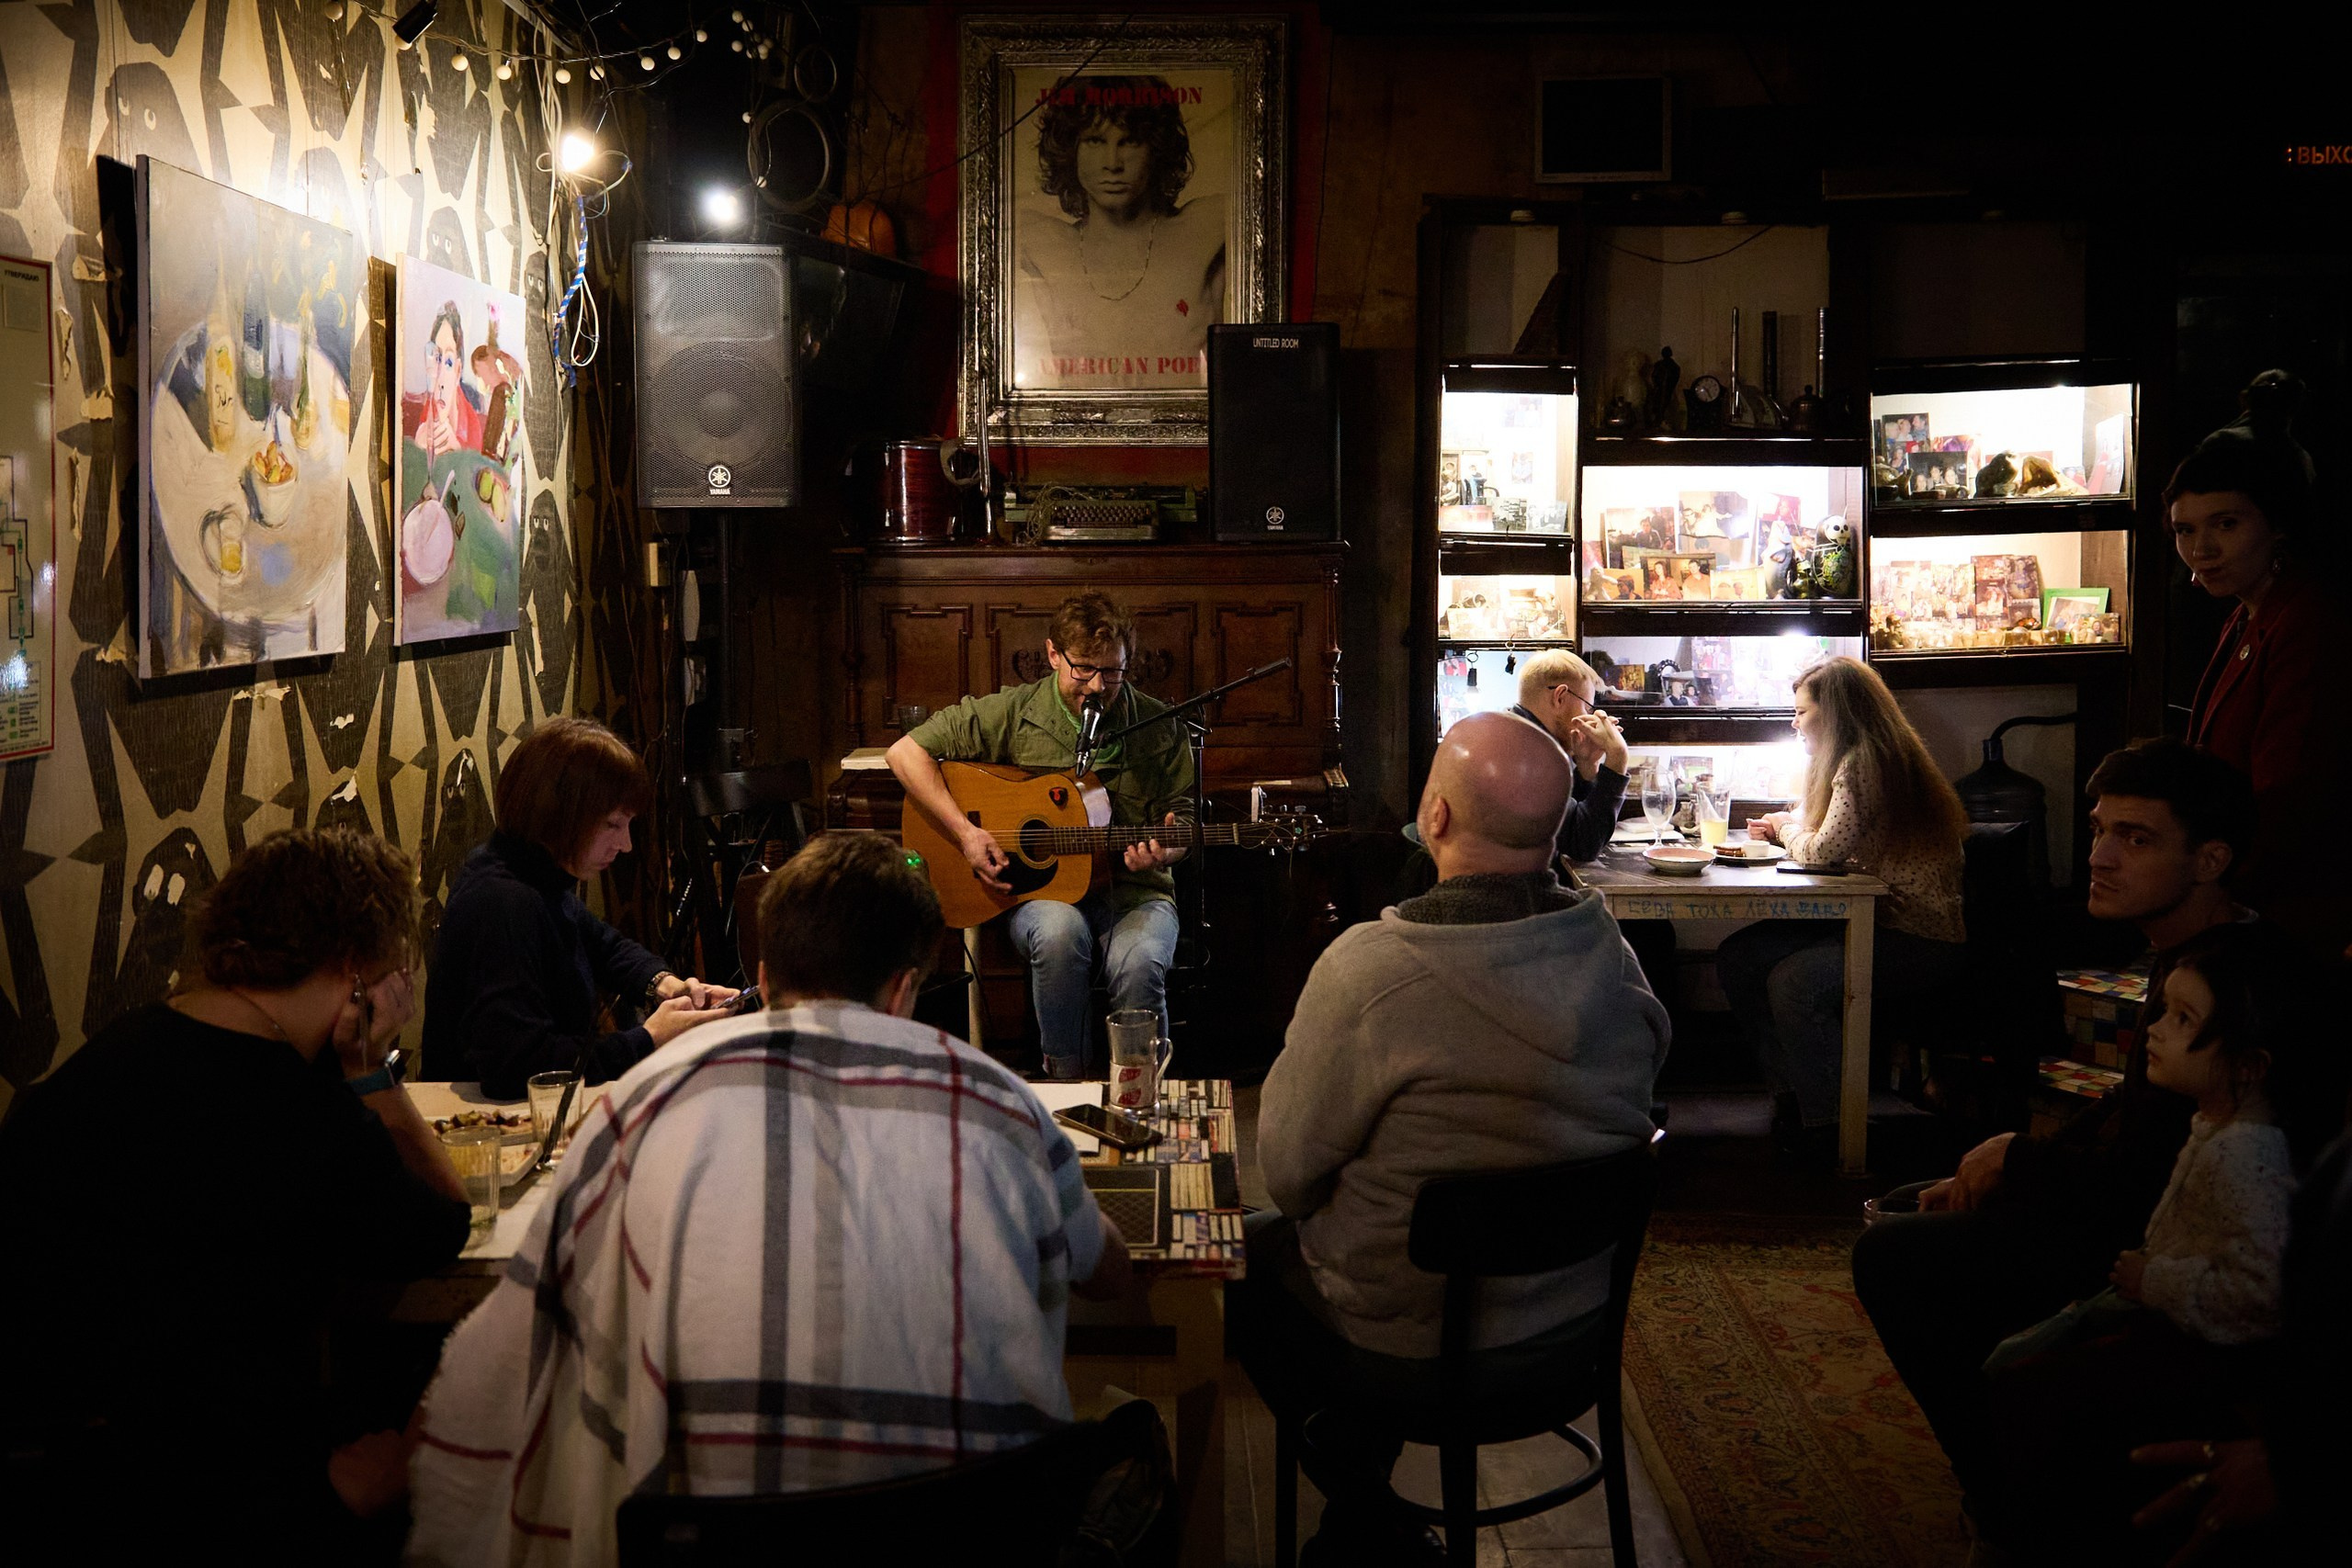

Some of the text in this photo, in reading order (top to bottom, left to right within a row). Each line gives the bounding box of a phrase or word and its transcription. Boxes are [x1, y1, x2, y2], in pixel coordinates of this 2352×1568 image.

[1035, 87, 1203, 106] JIM MORRISON
[1252, 337, 1299, 348] UNTITLED ROOM
[1157, 355, 1204, 375] POE
